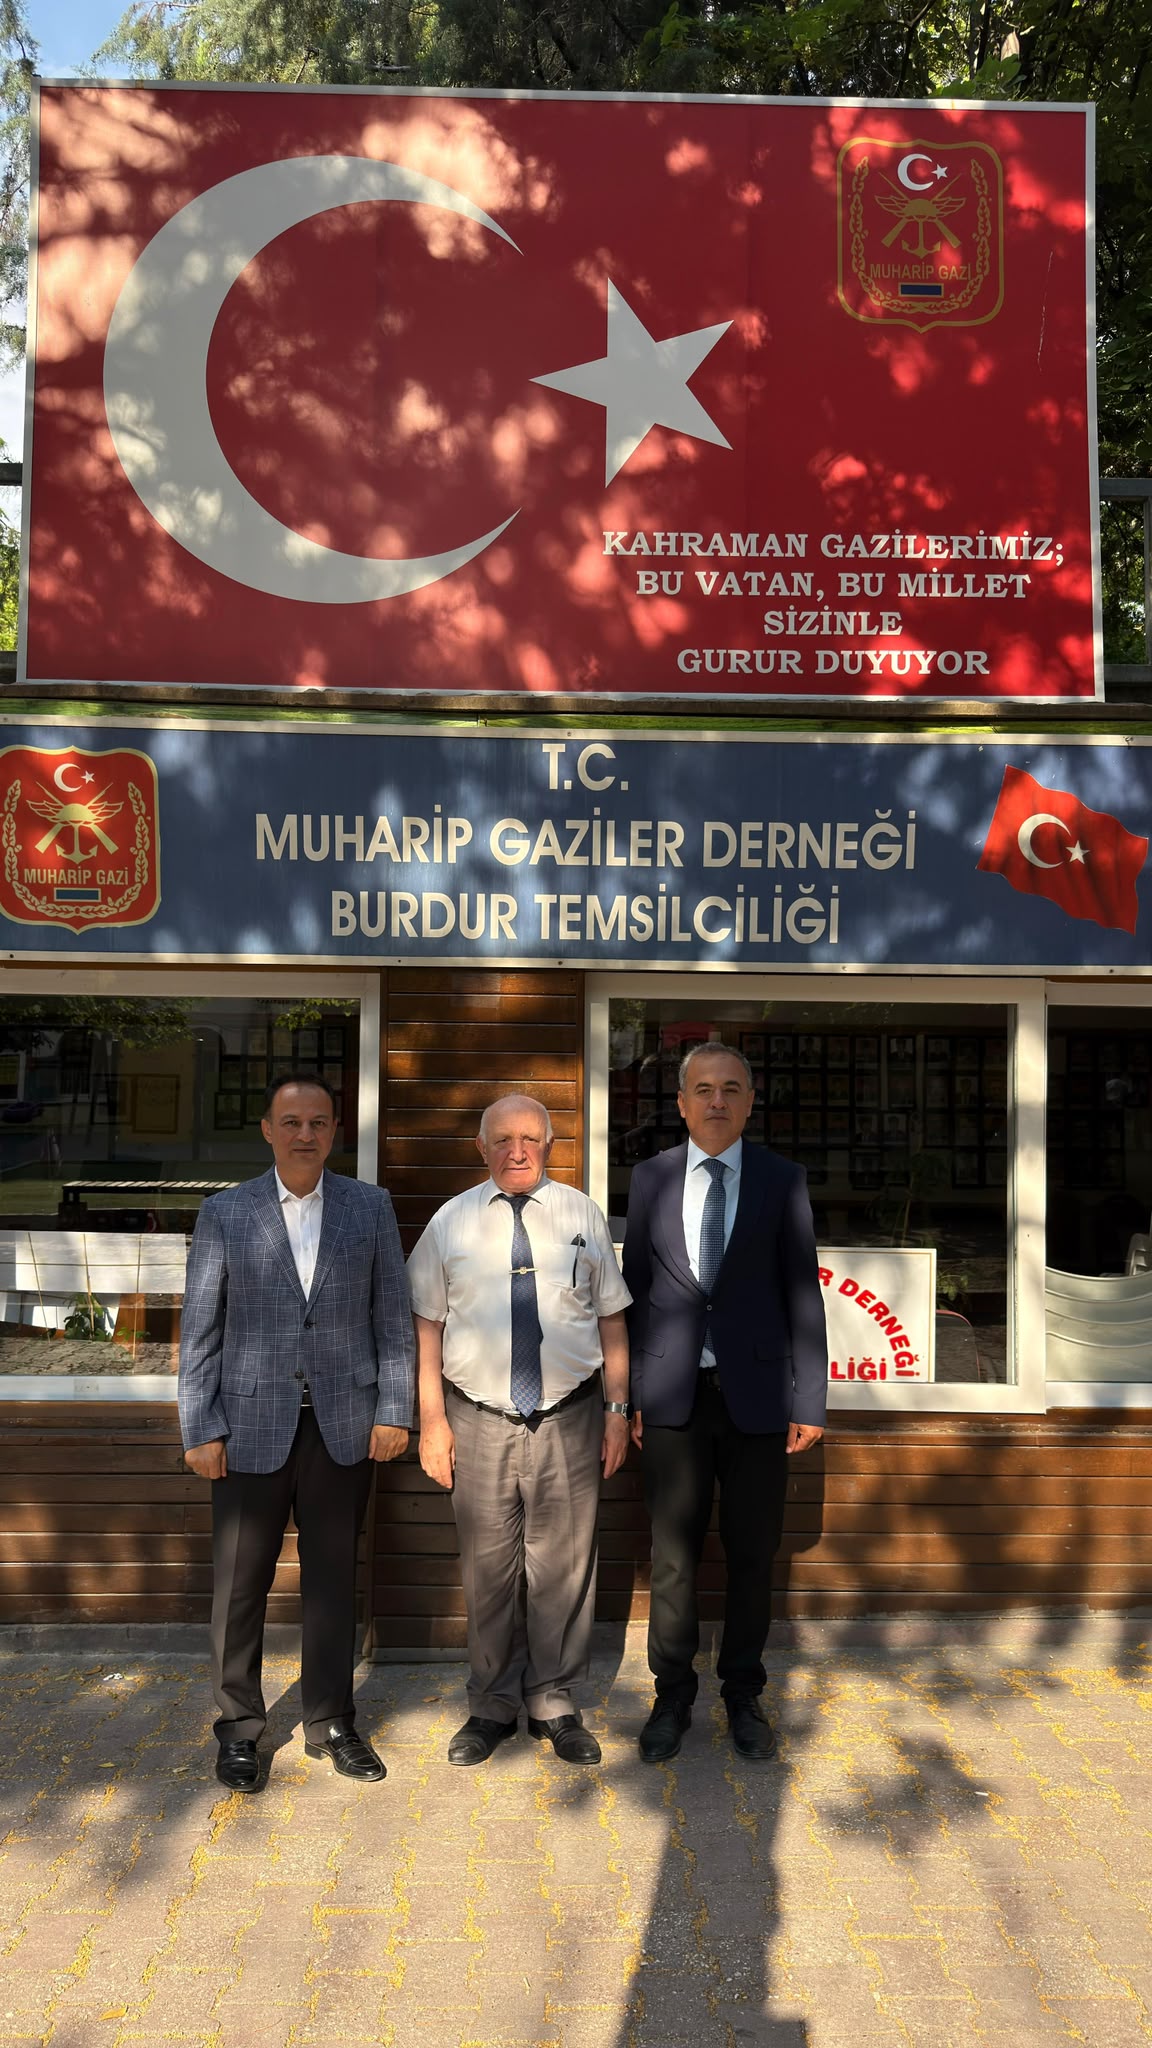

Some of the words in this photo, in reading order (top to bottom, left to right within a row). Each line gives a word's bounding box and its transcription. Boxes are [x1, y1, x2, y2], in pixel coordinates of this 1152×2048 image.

[870, 263, 935, 279] MUHARİP
[938, 263, 972, 281] GAZİ
[602, 531, 808, 559] KAHRAMAN
[820, 528, 1065, 567] GAZİLERİMİZ;
[636, 570, 683, 595] BU
[696, 572, 825, 602] VATAN,
[838, 573, 886, 597] BU
[897, 567, 1032, 599] MİLLET
[764, 604, 903, 636] SİZİNLE
[677, 649, 804, 674] GURUR
[815, 650, 990, 675] DUYUYOR
[542, 743, 629, 791] T.C.
[256, 804, 473, 864] MUHARİP
[489, 806, 685, 867] GAZİLER
[703, 808, 917, 870] DERNEĞİ
[24, 865, 92, 885] MUHARİP
[96, 866, 129, 886] GAZİ
[331, 890, 518, 940] BURDUR
[534, 883, 840, 944] TEMSİLCİLİĞİ
[838, 1278, 920, 1377] DERNEĞİ
